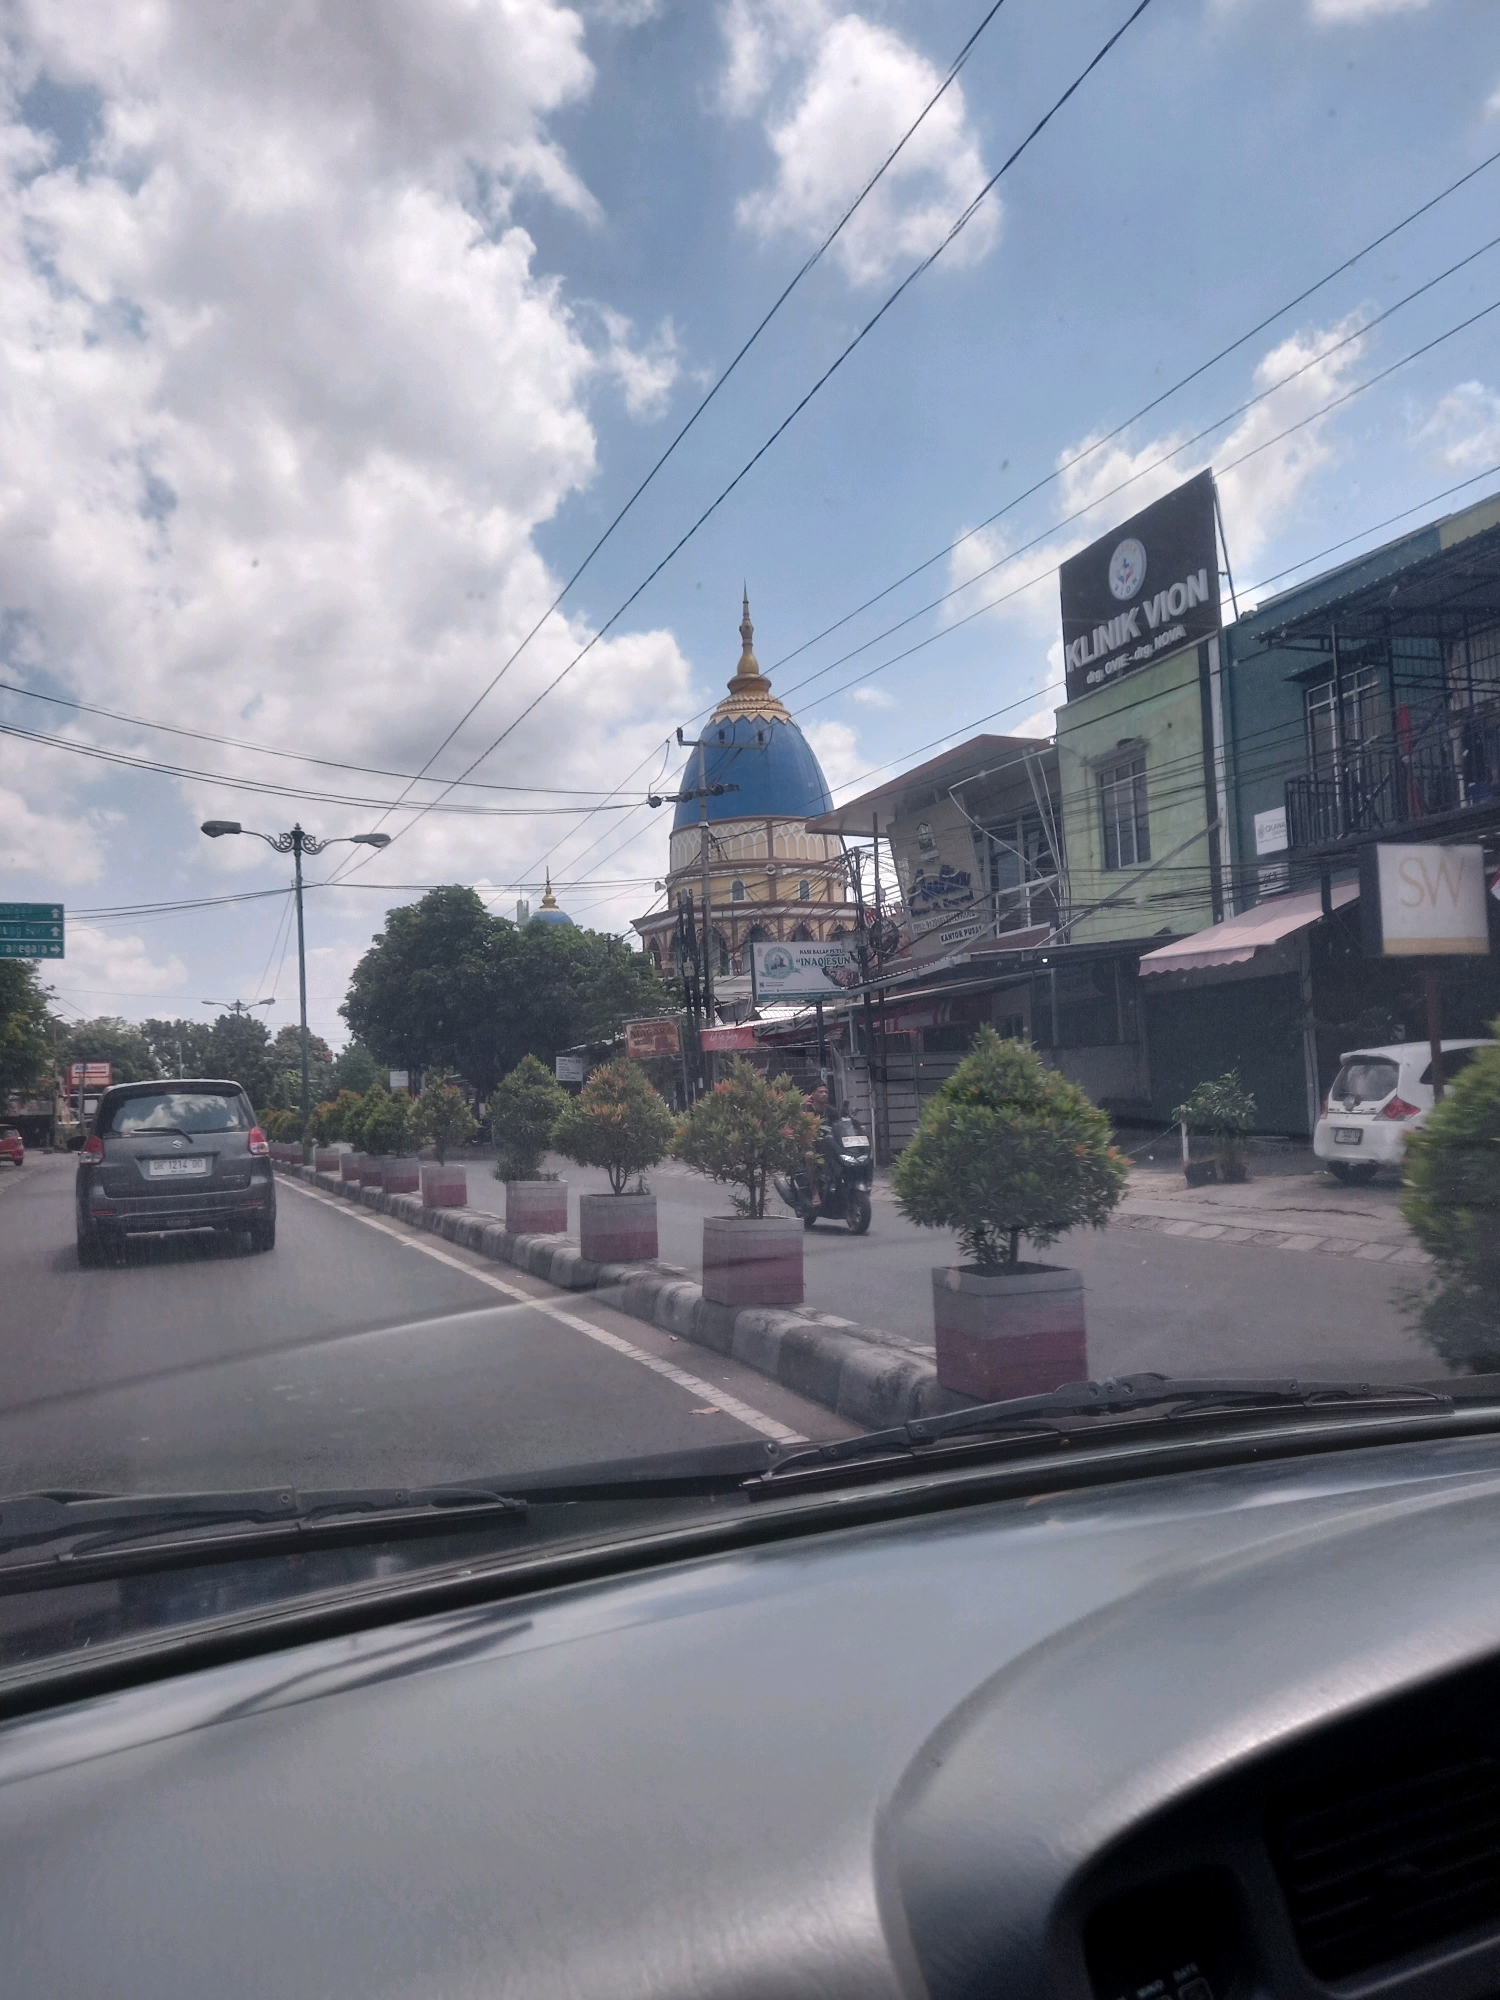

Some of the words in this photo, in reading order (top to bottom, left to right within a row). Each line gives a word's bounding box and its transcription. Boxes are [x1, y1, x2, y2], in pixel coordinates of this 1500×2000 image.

[1065, 606, 1142, 673] KLINIK
[1143, 568, 1210, 629] VION
[1154, 625, 1187, 650] NOVA
[1398, 856, 1467, 908] SW
[940, 930, 963, 943] KANTOR
[168, 1158, 188, 1170] 1214
